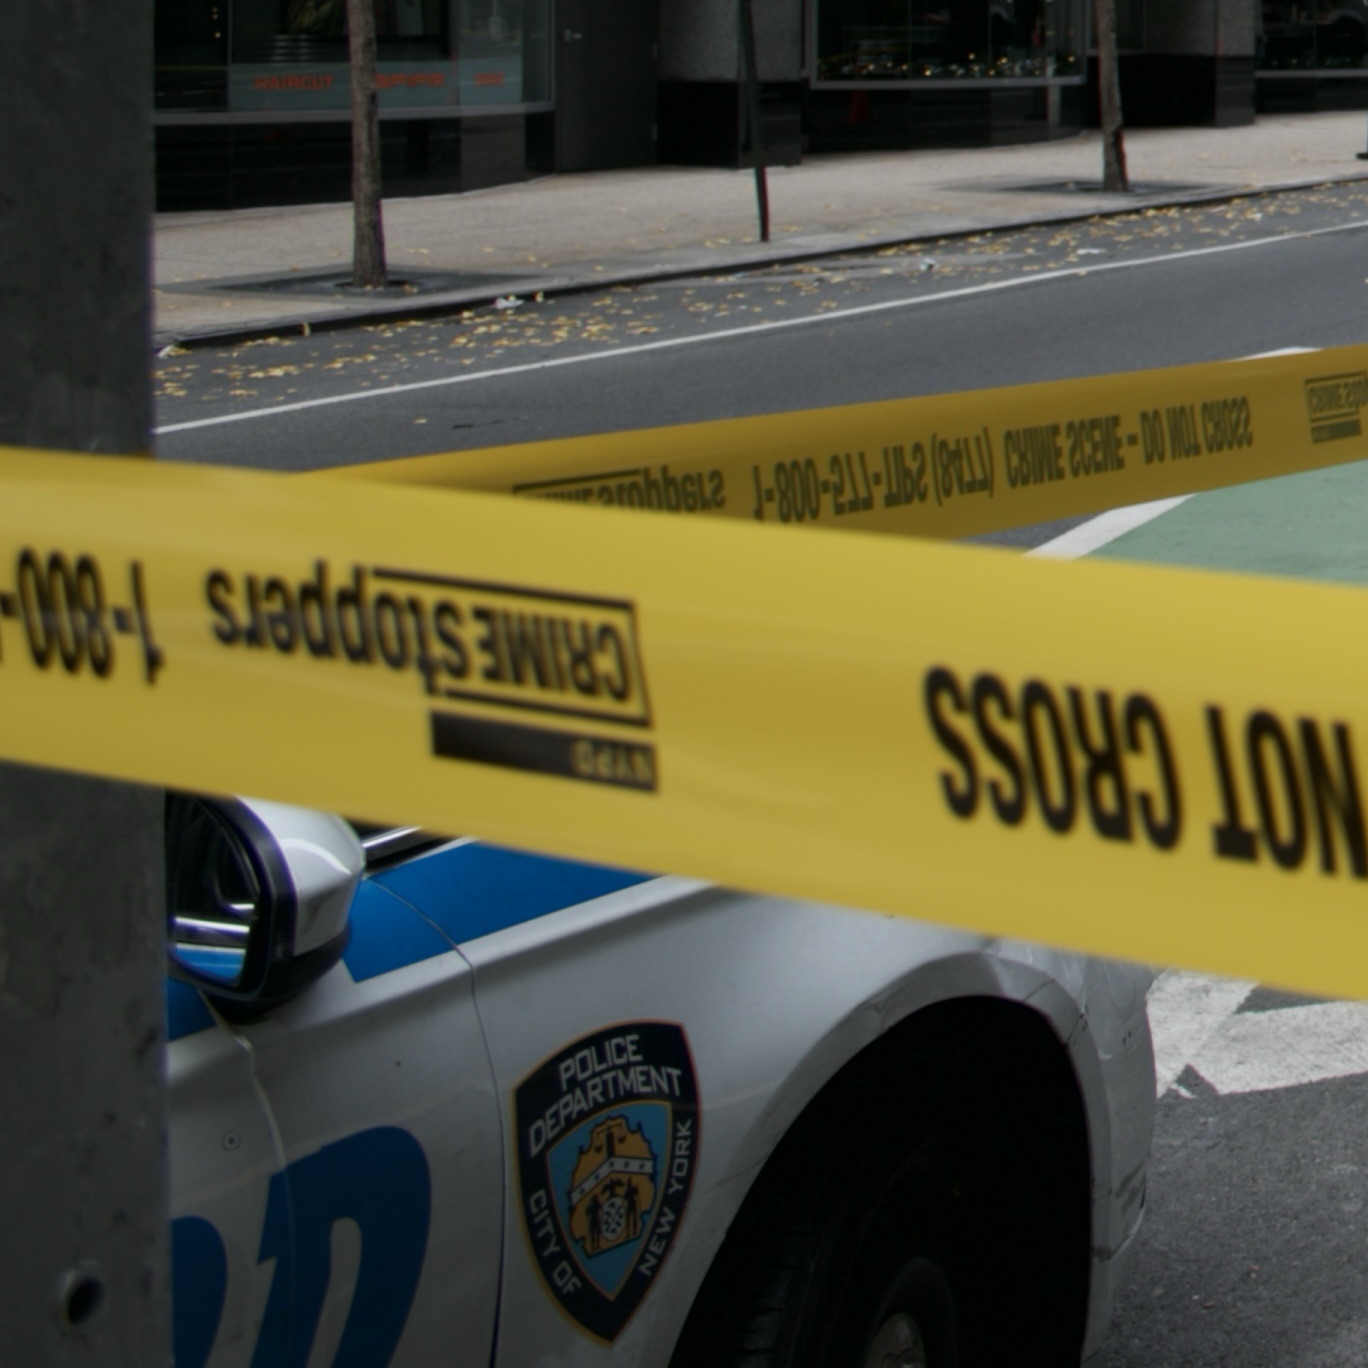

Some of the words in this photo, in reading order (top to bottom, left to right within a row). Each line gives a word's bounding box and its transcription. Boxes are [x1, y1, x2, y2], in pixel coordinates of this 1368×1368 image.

[254, 75, 334, 90] HAIRCUT
[0, 547, 164, 686] 1-800-
[923, 665, 1183, 852] CROSS
[529, 1065, 682, 1159] DEPARTMENT
[559, 1034, 643, 1092] POLICE
[529, 1188, 560, 1259] CITY
[552, 1260, 582, 1295] OF
[638, 1206, 675, 1276] NEW
[668, 1118, 693, 1195] YORK
